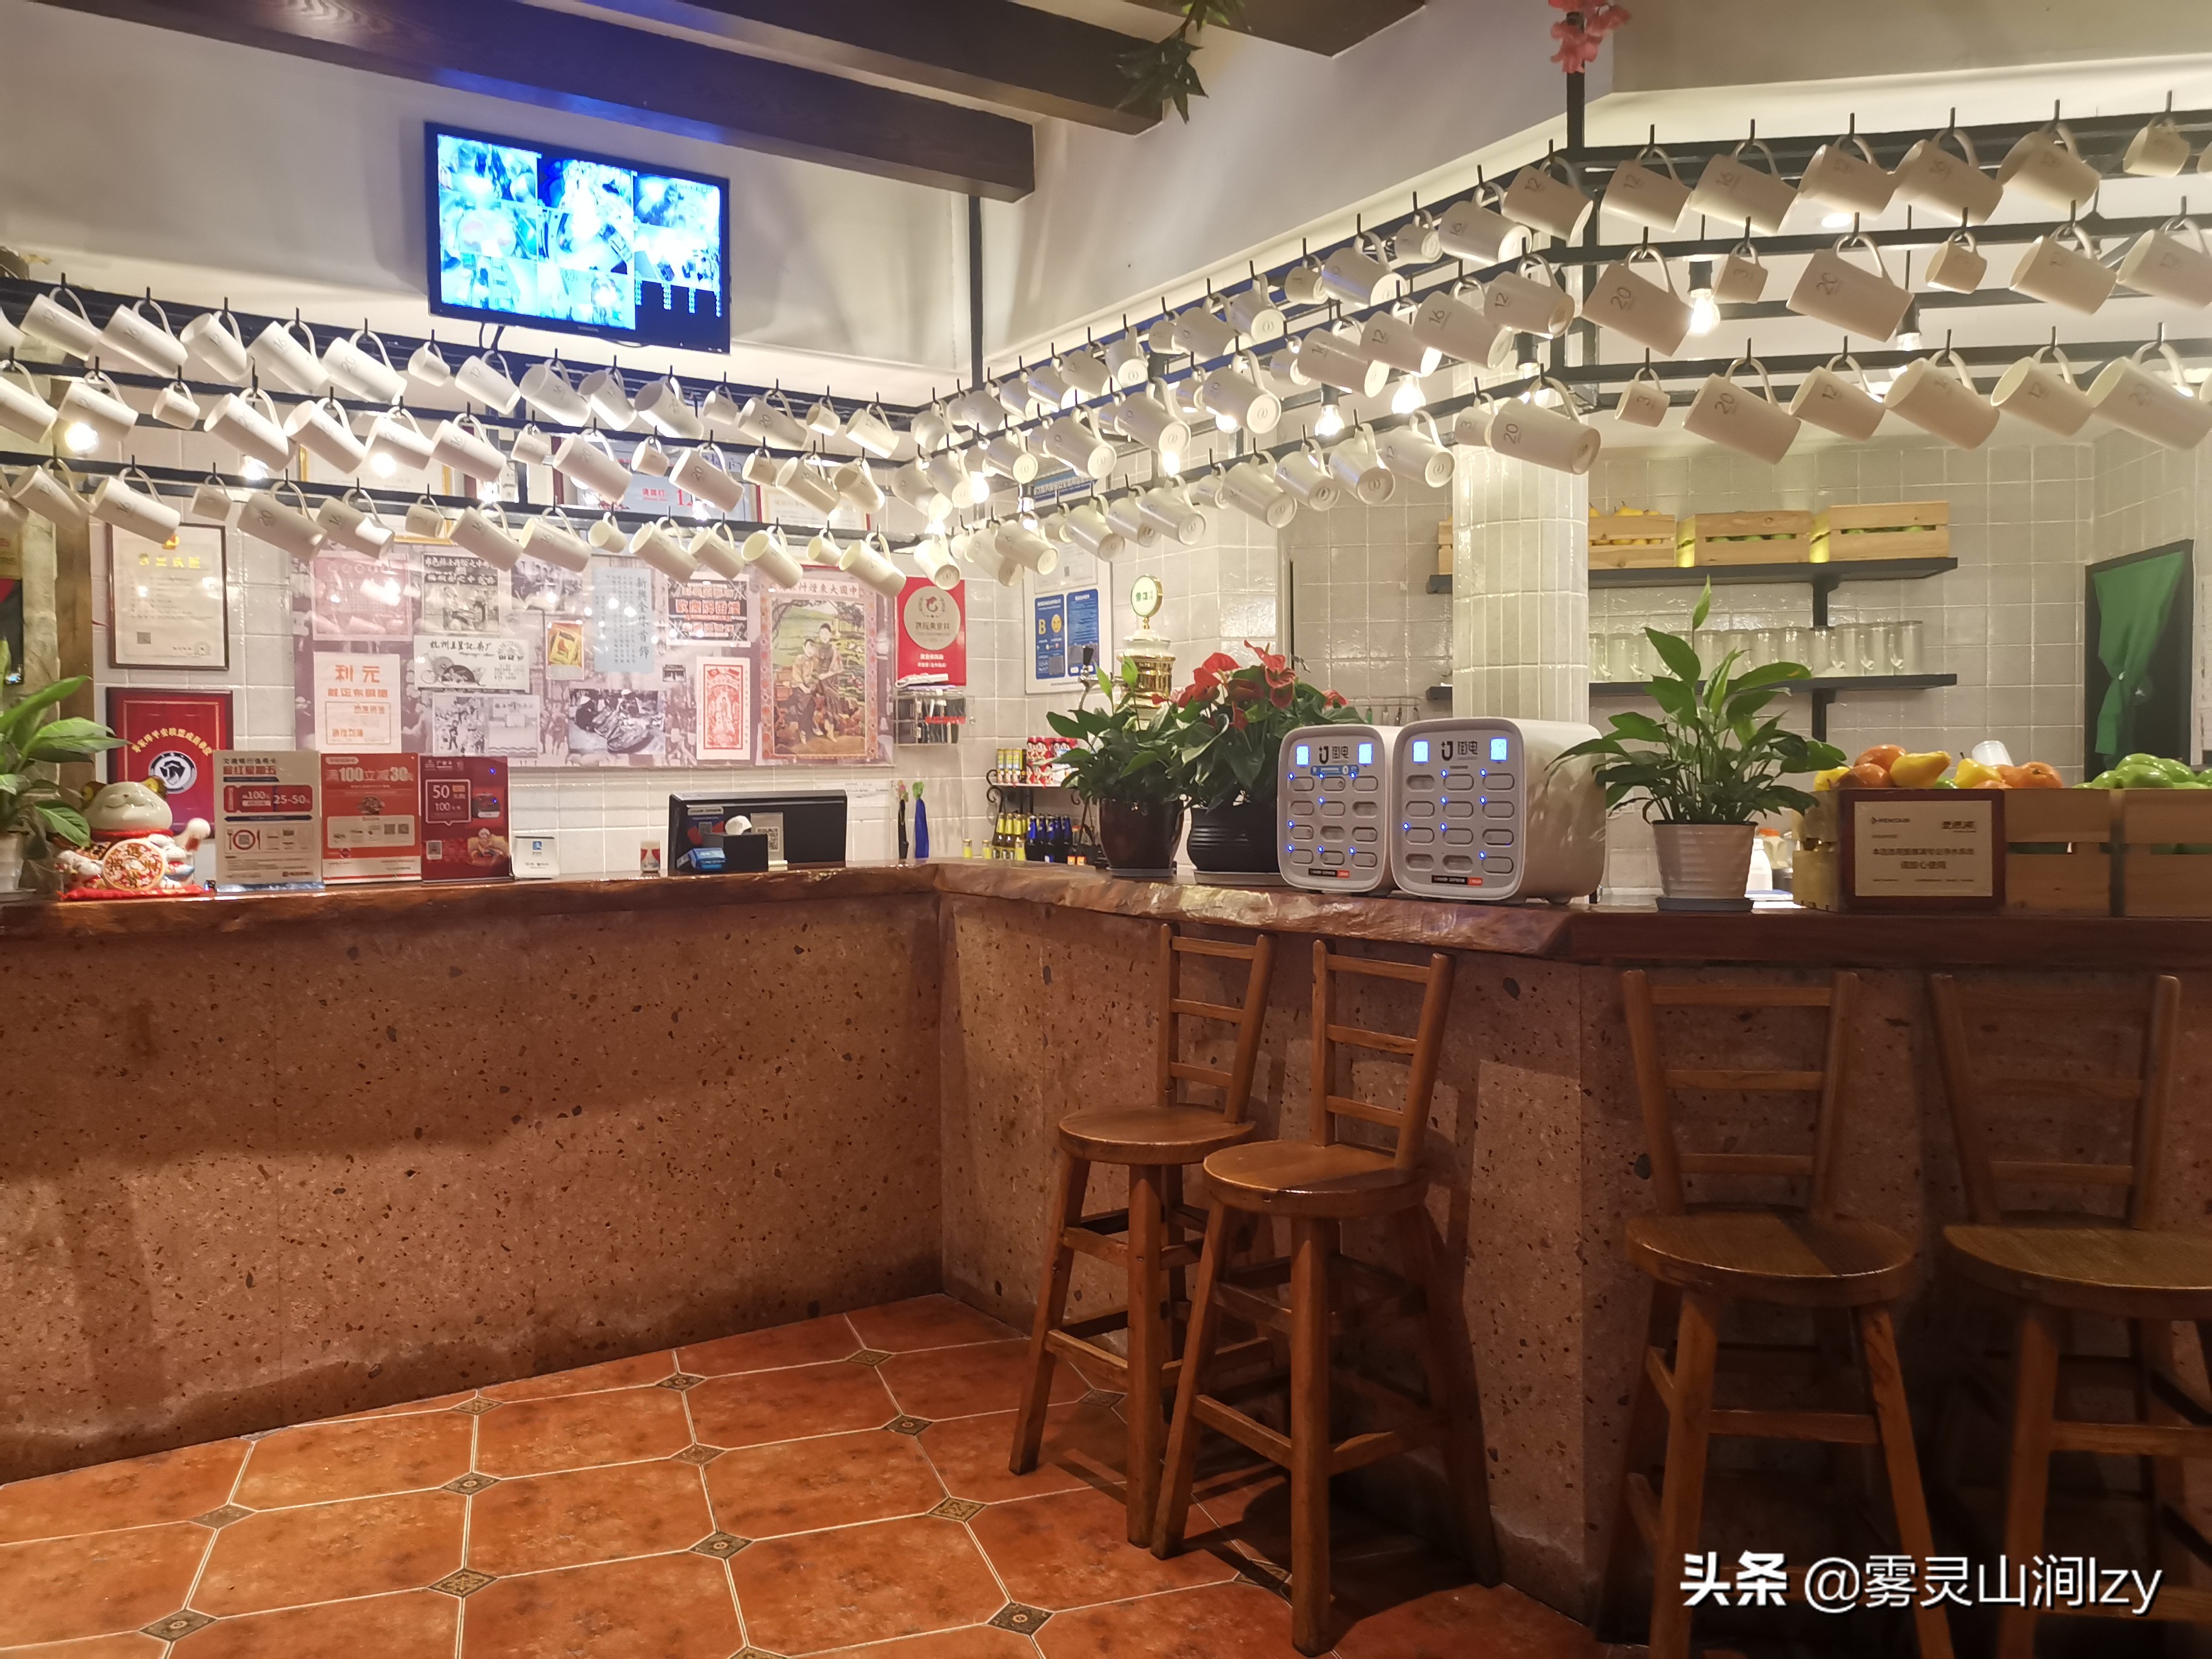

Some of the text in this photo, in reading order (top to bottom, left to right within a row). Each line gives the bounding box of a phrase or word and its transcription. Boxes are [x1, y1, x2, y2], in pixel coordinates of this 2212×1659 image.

[1525, 178, 1539, 191] 12
[1624, 175, 1640, 189] 12
[1716, 173, 1733, 186] 16
[1450, 223, 1462, 235] 16
[1494, 292, 1511, 309] 12
[1610, 286, 1632, 310] 20
[1429, 310, 1445, 324] 16
[273, 336, 287, 349] 16
[1372, 329, 1386, 344] 12
[341, 357, 356, 374] 20
[471, 366, 481, 378] 12
[1822, 384, 1838, 401] 12
[2029, 383, 2045, 398] 12
[1637, 395, 1651, 407] 3
[1715, 392, 1735, 415] 20
[759, 414, 771, 428] 20
[1460, 420, 1472, 429] 3
[1504, 423, 1520, 444] 20
[579, 449, 592, 463] 20
[1386, 446, 1396, 460] 12
[691, 466, 704, 481] 20
[257, 511, 273, 527] 20
[328, 515, 341, 526] 16
[472, 520, 486, 531] 16
[541, 531, 552, 543] 16
[432, 785, 450, 799] 50
